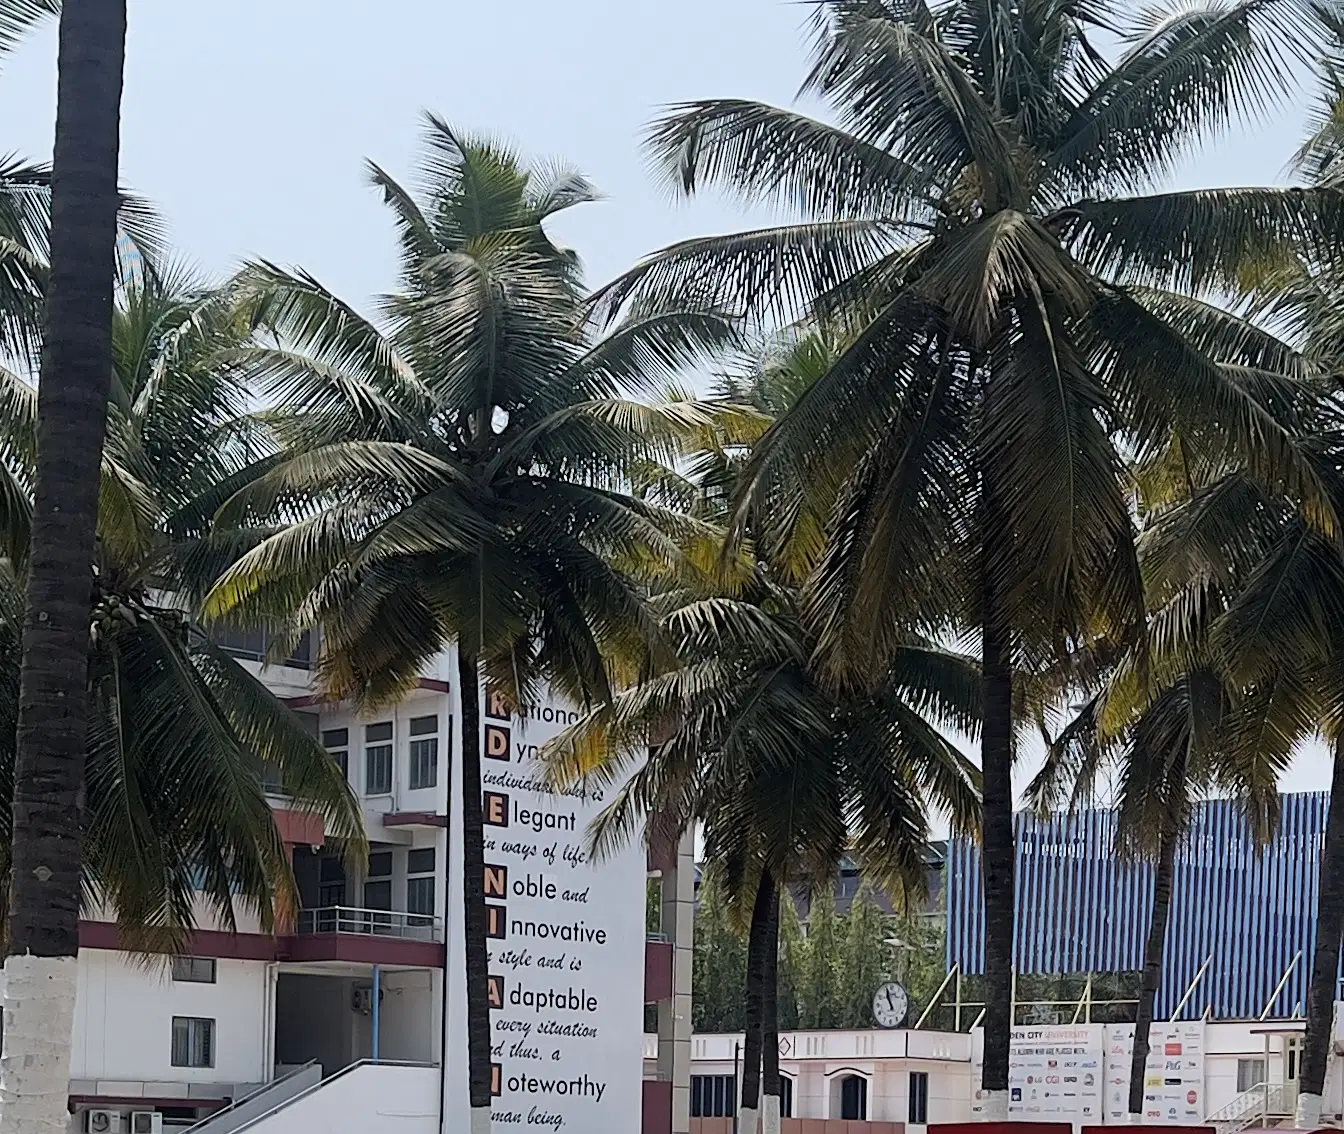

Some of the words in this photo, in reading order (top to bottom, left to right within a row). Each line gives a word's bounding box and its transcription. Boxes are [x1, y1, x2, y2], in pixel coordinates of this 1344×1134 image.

[501, 840, 537, 861] ways
[542, 842, 558, 866] of
[561, 887, 590, 904] and
[499, 948, 533, 970] style
[537, 953, 566, 971] and
[570, 957, 583, 971] is
[495, 1019, 532, 1038] every
[536, 1020, 599, 1039] situation
[1027, 1031, 1044, 1039] CITY
[551, 1050, 562, 1061] a
